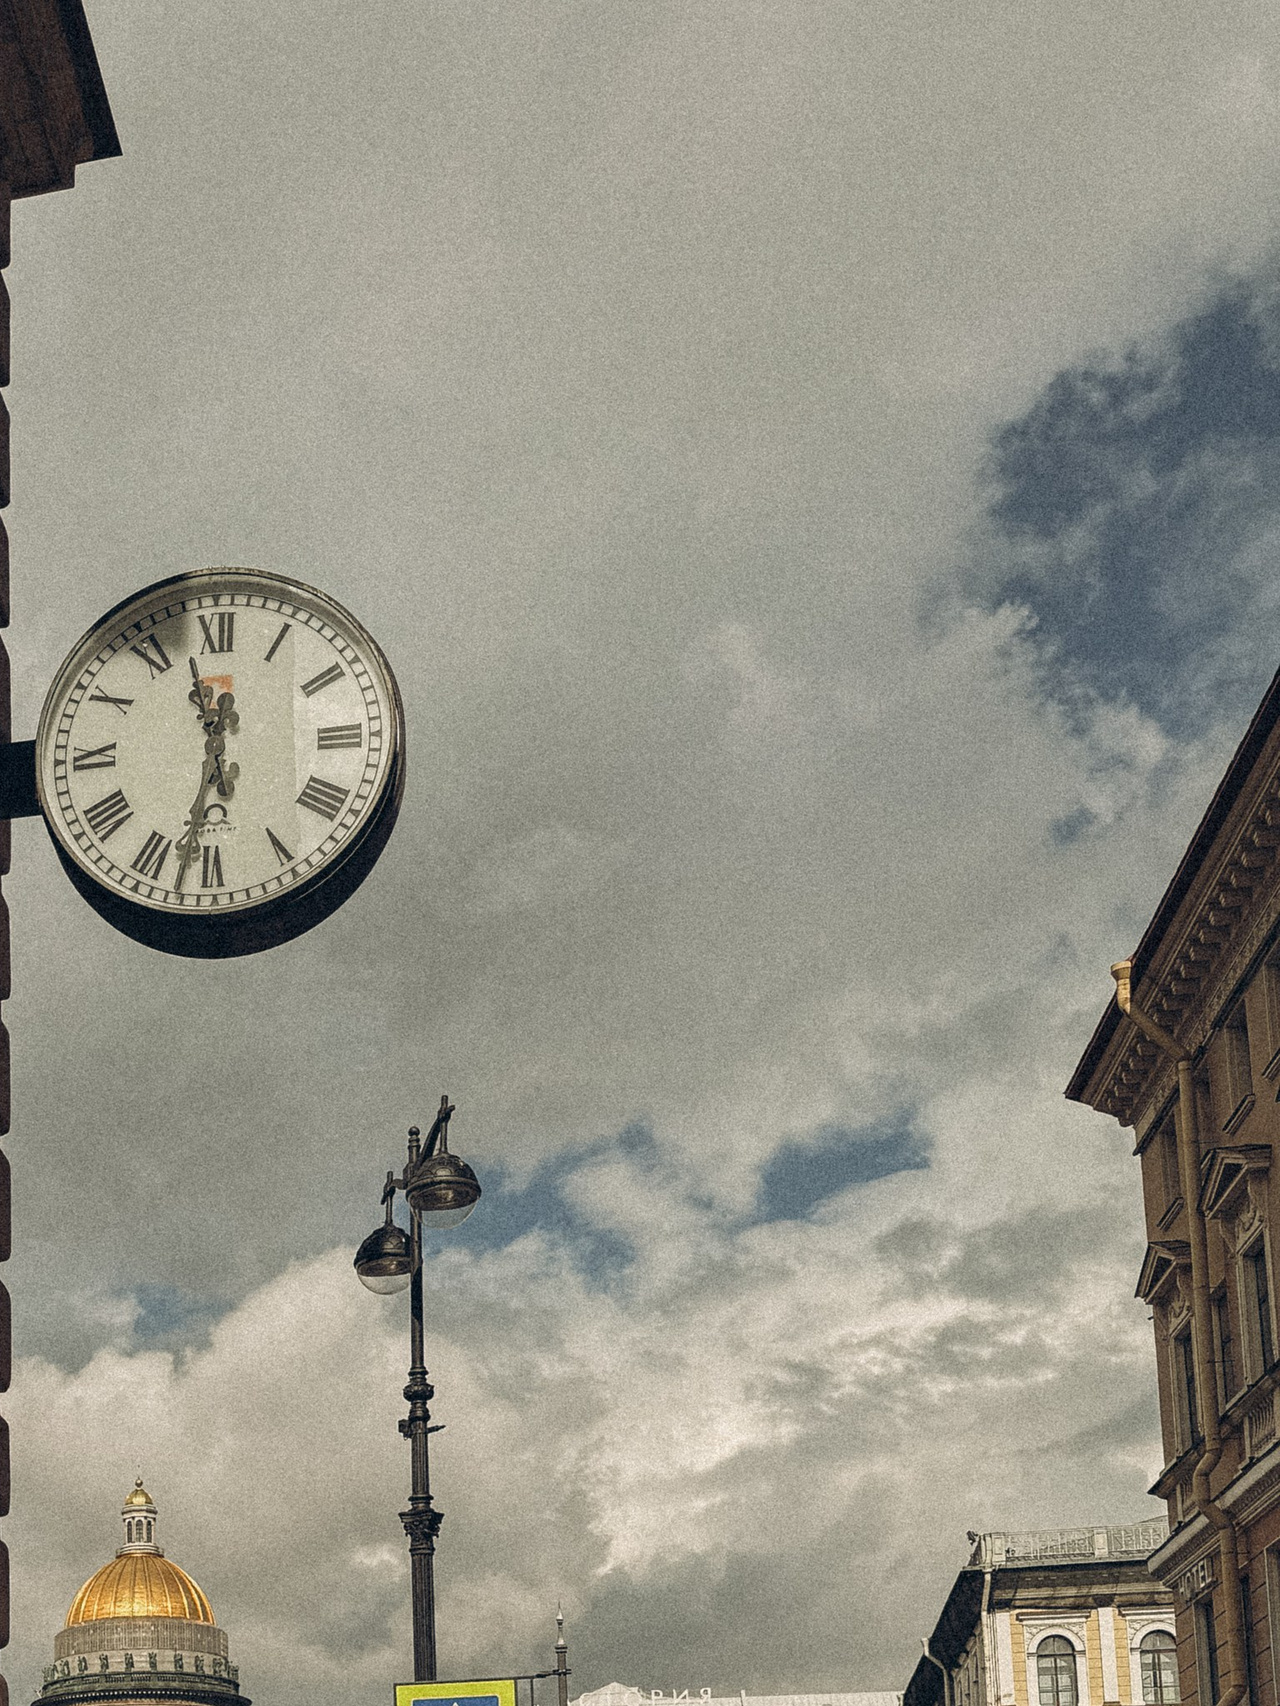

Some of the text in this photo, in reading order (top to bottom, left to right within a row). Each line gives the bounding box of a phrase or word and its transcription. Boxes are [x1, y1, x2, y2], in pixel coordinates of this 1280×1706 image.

[196, 611, 236, 655] XII
[263, 621, 292, 662] I
[129, 633, 174, 680] XI
[88, 685, 134, 715] X
[300, 661, 346, 698] II
[72, 741, 117, 773] IX
[317, 722, 362, 751] III
[83, 787, 134, 844] VIII
[295, 774, 351, 822] IIII
[129, 829, 173, 881] VII
[200, 845, 226, 888] VI
[265, 827, 295, 867] V
[1178, 1557, 1212, 1601] HOTEL
